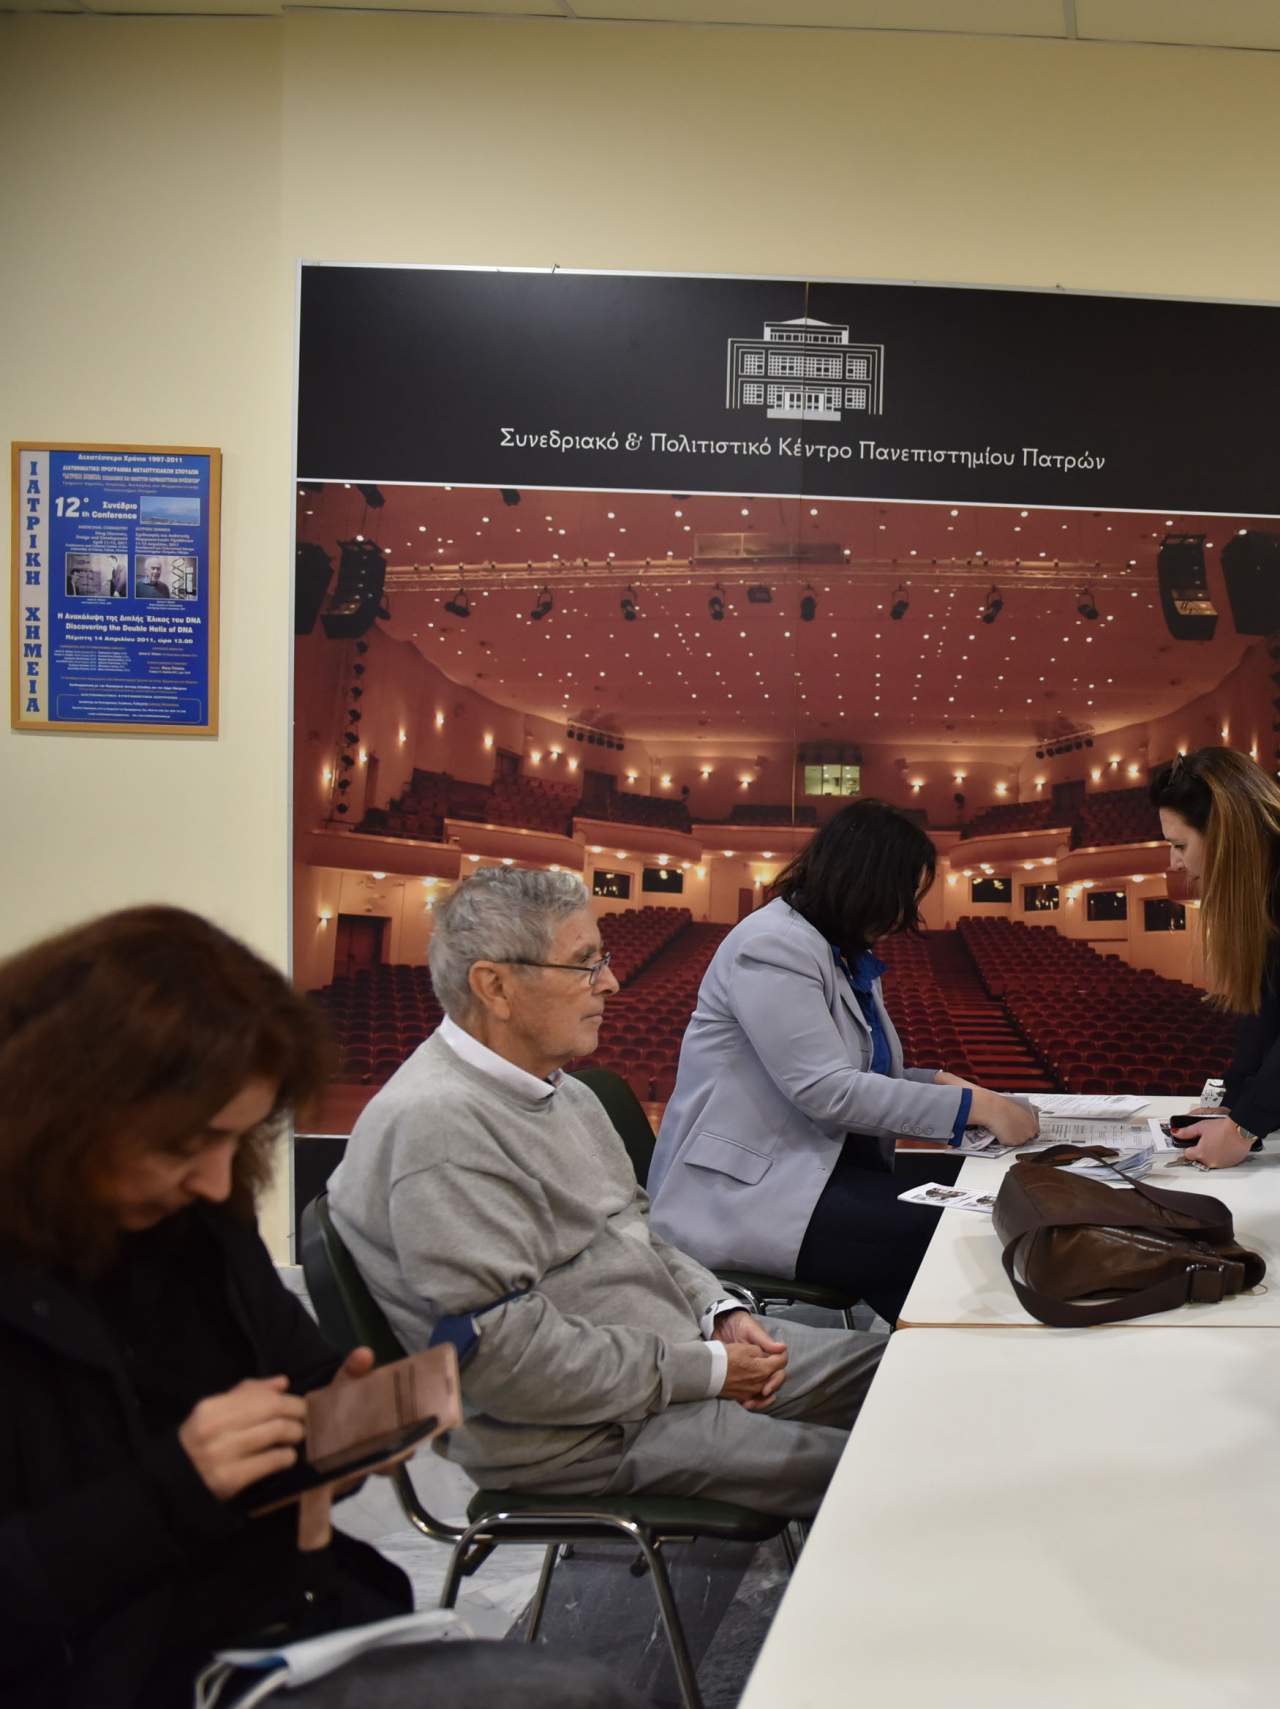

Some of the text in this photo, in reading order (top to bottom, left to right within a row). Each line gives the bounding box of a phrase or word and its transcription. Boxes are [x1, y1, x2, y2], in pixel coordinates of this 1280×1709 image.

[500, 427, 1105, 472] Συνεδριακό & Πολιτιστικό Κέντρο Πανεπιστημίου Πατρών
[102, 501, 138, 511] Συνέδριο
[91, 511, 138, 520] Conference
[24, 461, 42, 713] ΙΑΤΡΙΚΗ ΧΗΜΕΙΑ
[65, 622, 108, 632] Discovering
[122, 624, 148, 632] Double
